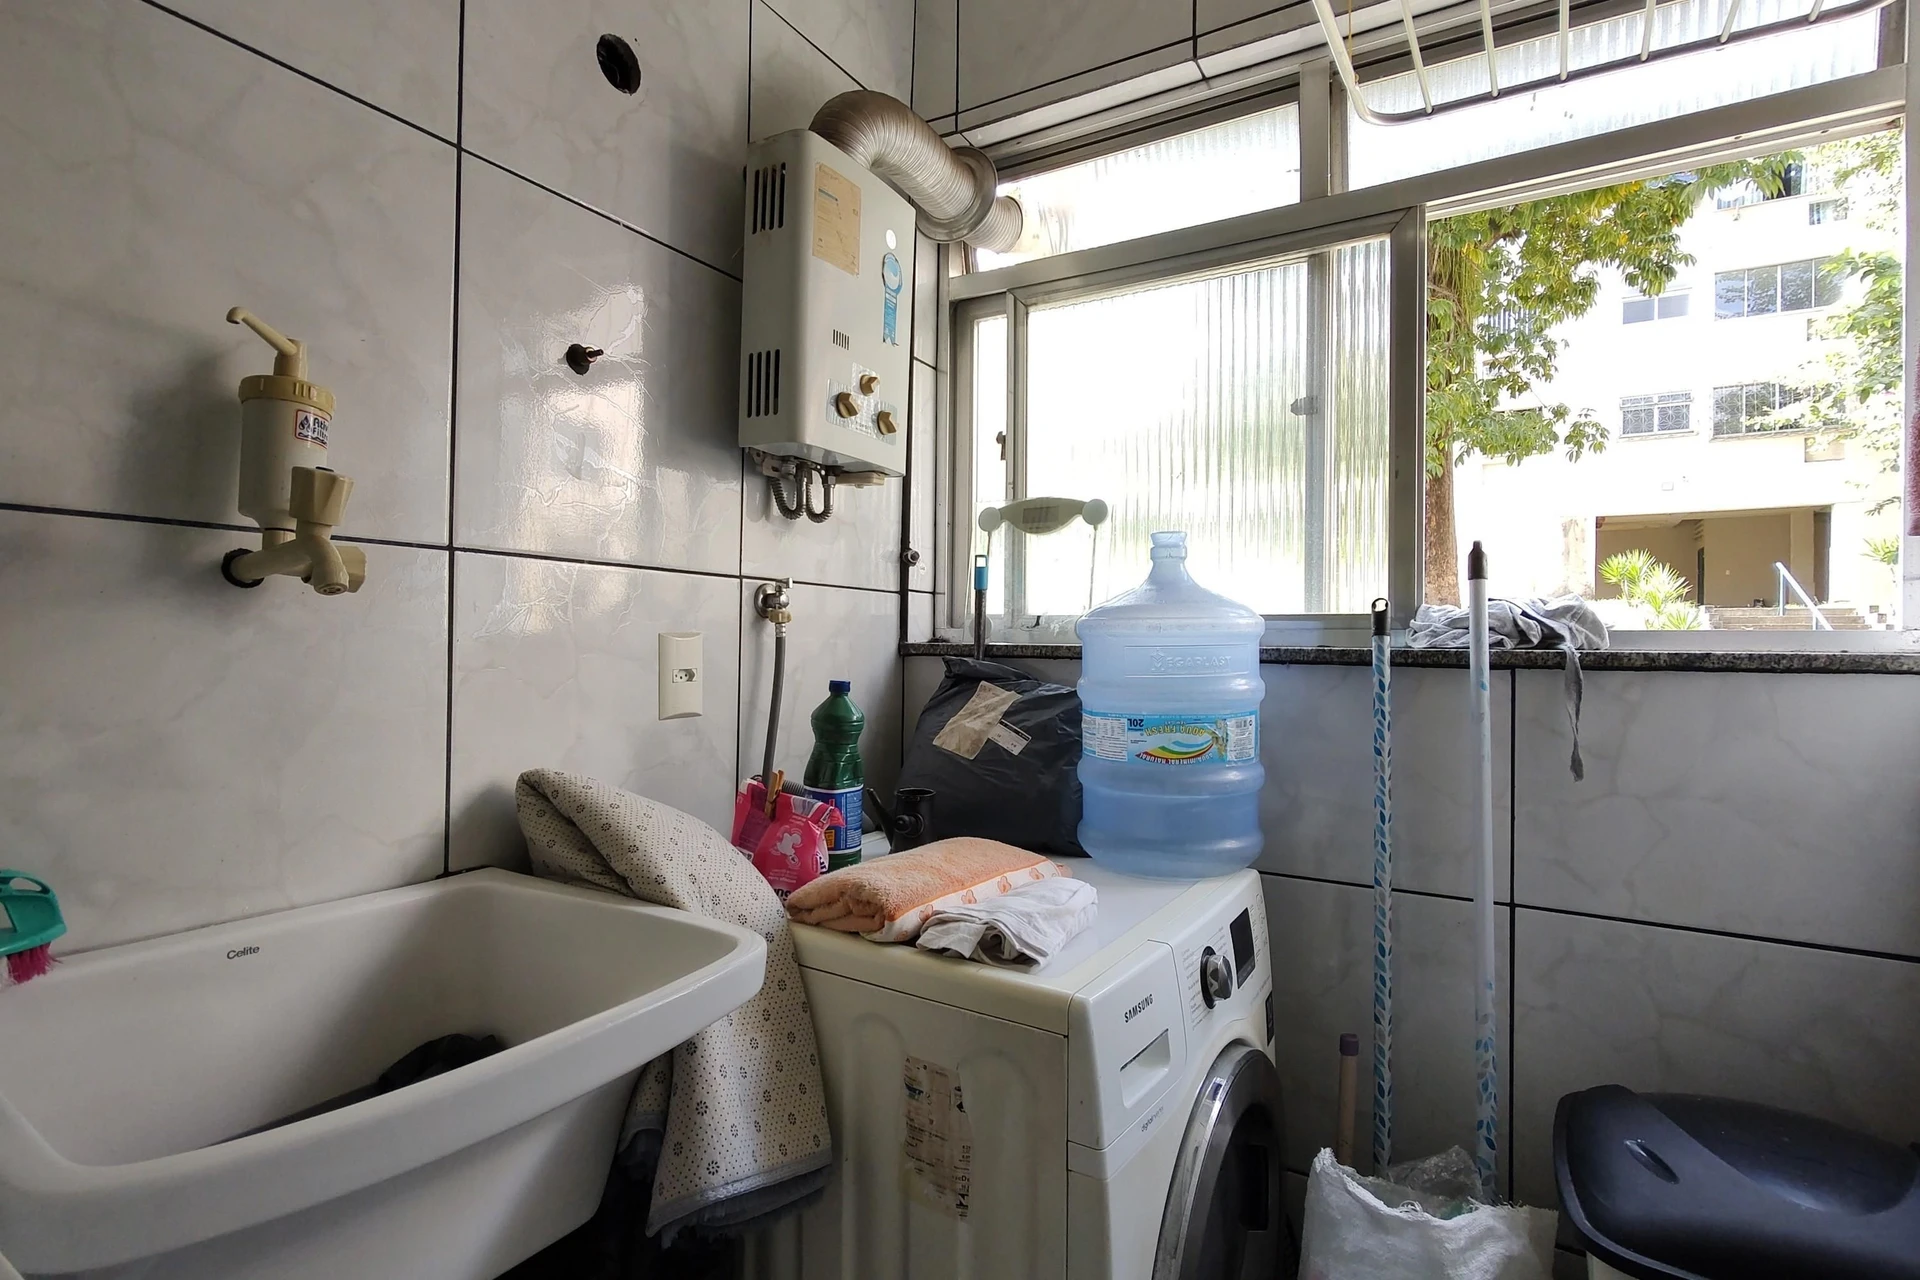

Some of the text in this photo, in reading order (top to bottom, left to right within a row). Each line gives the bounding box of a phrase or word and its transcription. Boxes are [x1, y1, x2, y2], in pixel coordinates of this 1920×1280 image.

[1127, 718, 1144, 727] 20L
[1144, 724, 1206, 737] AQUA FRESH
[227, 946, 260, 960] Celite
[1124, 994, 1153, 1023] SAMSUNG
